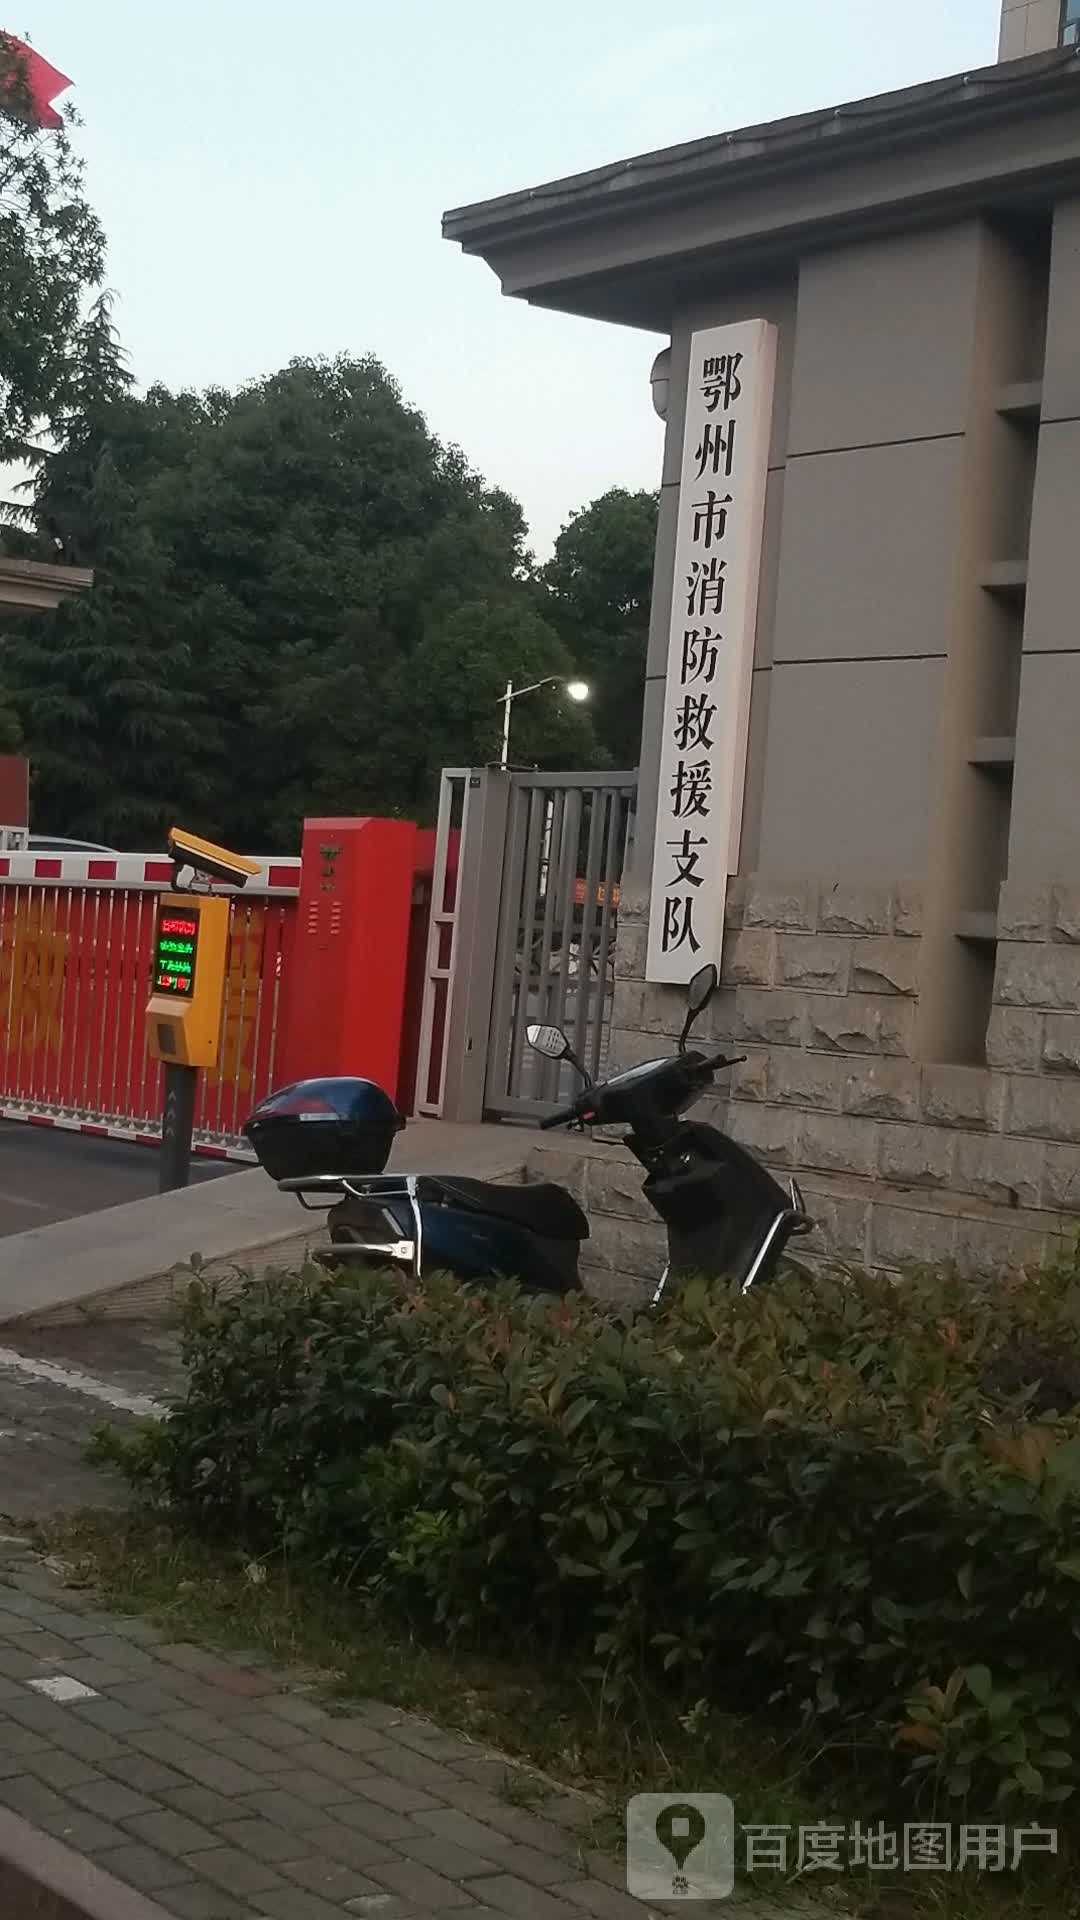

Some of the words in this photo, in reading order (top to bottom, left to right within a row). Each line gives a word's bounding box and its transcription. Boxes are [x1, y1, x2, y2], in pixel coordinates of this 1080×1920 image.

[661, 352, 744, 953] 鄂州市消防救援支队
